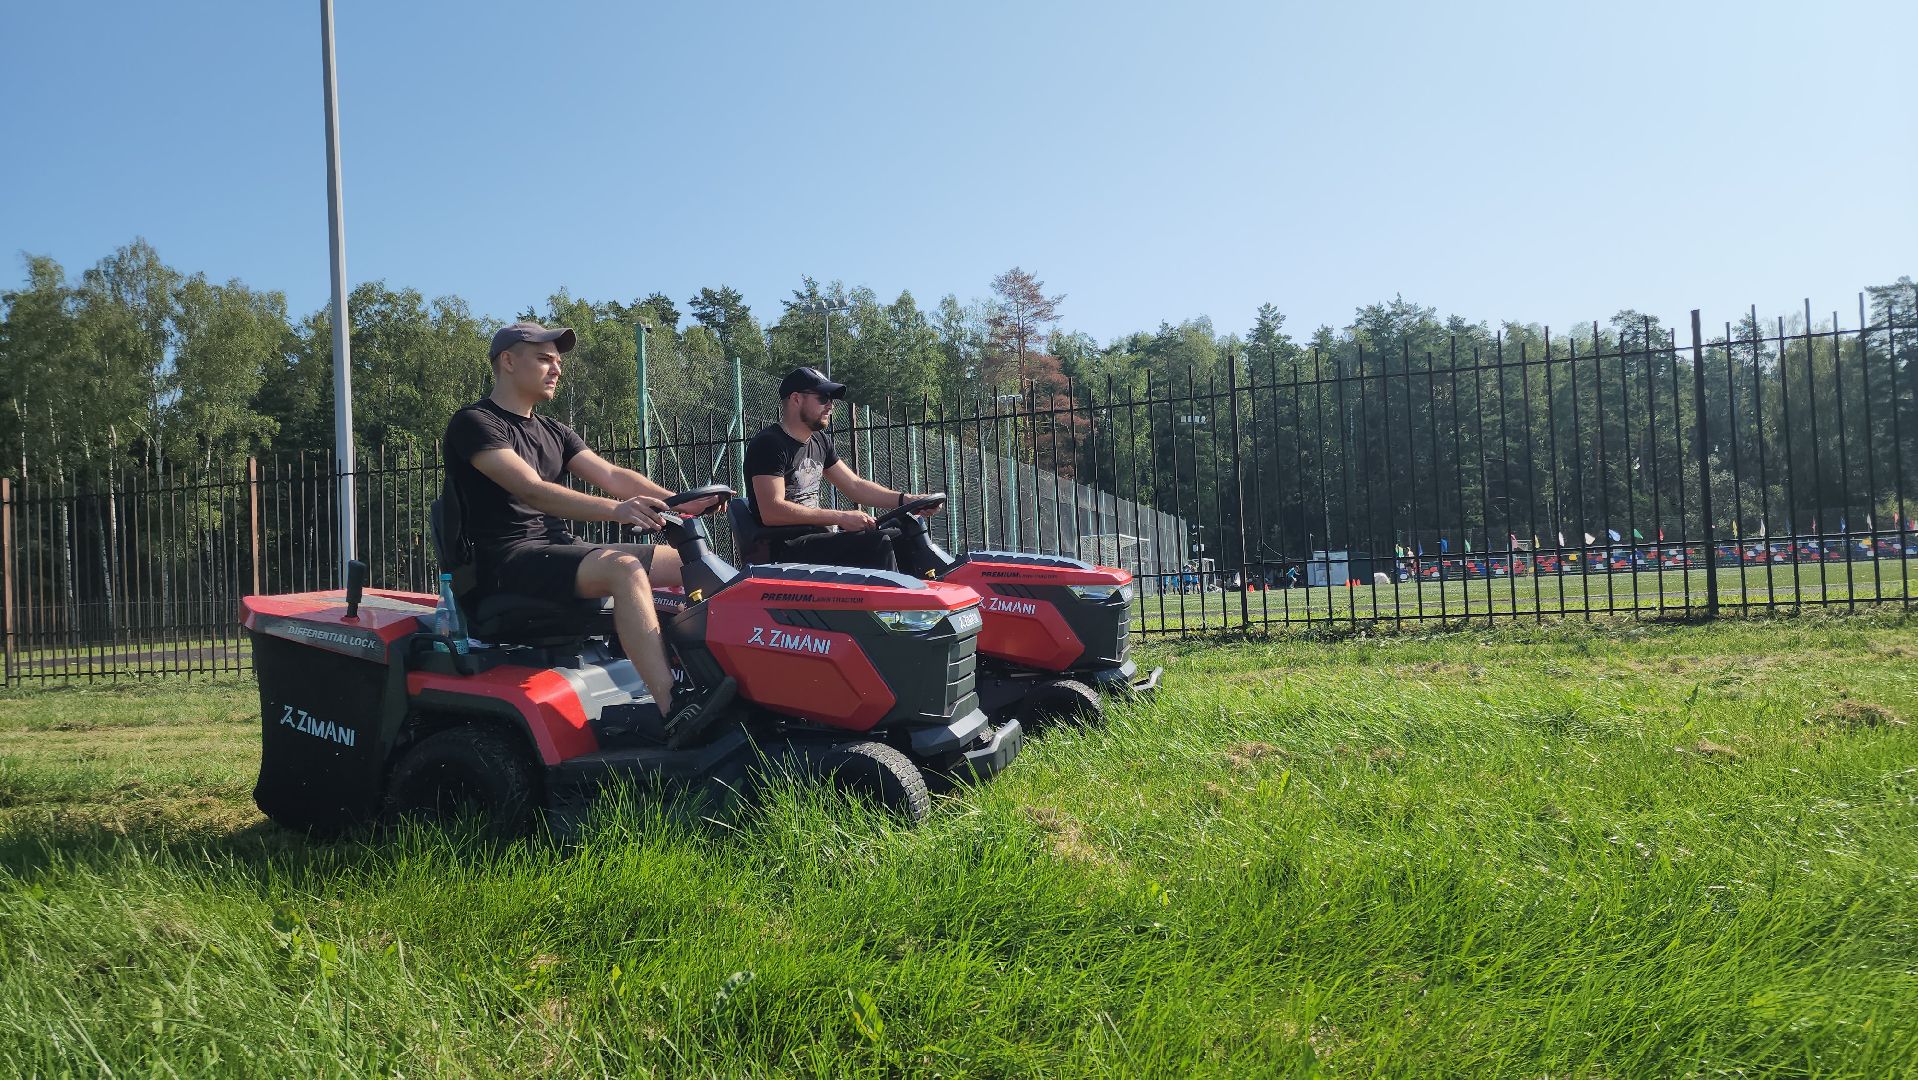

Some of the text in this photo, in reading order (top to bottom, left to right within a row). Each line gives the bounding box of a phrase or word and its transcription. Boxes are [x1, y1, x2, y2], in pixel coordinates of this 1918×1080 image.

[761, 592, 813, 603] PREMIUM
[989, 597, 1036, 615] ZIMANI
[287, 625, 376, 649] DIFFERENTIAL LOCK
[769, 629, 831, 654] ZIMANI
[297, 709, 355, 747] ZIMANI
